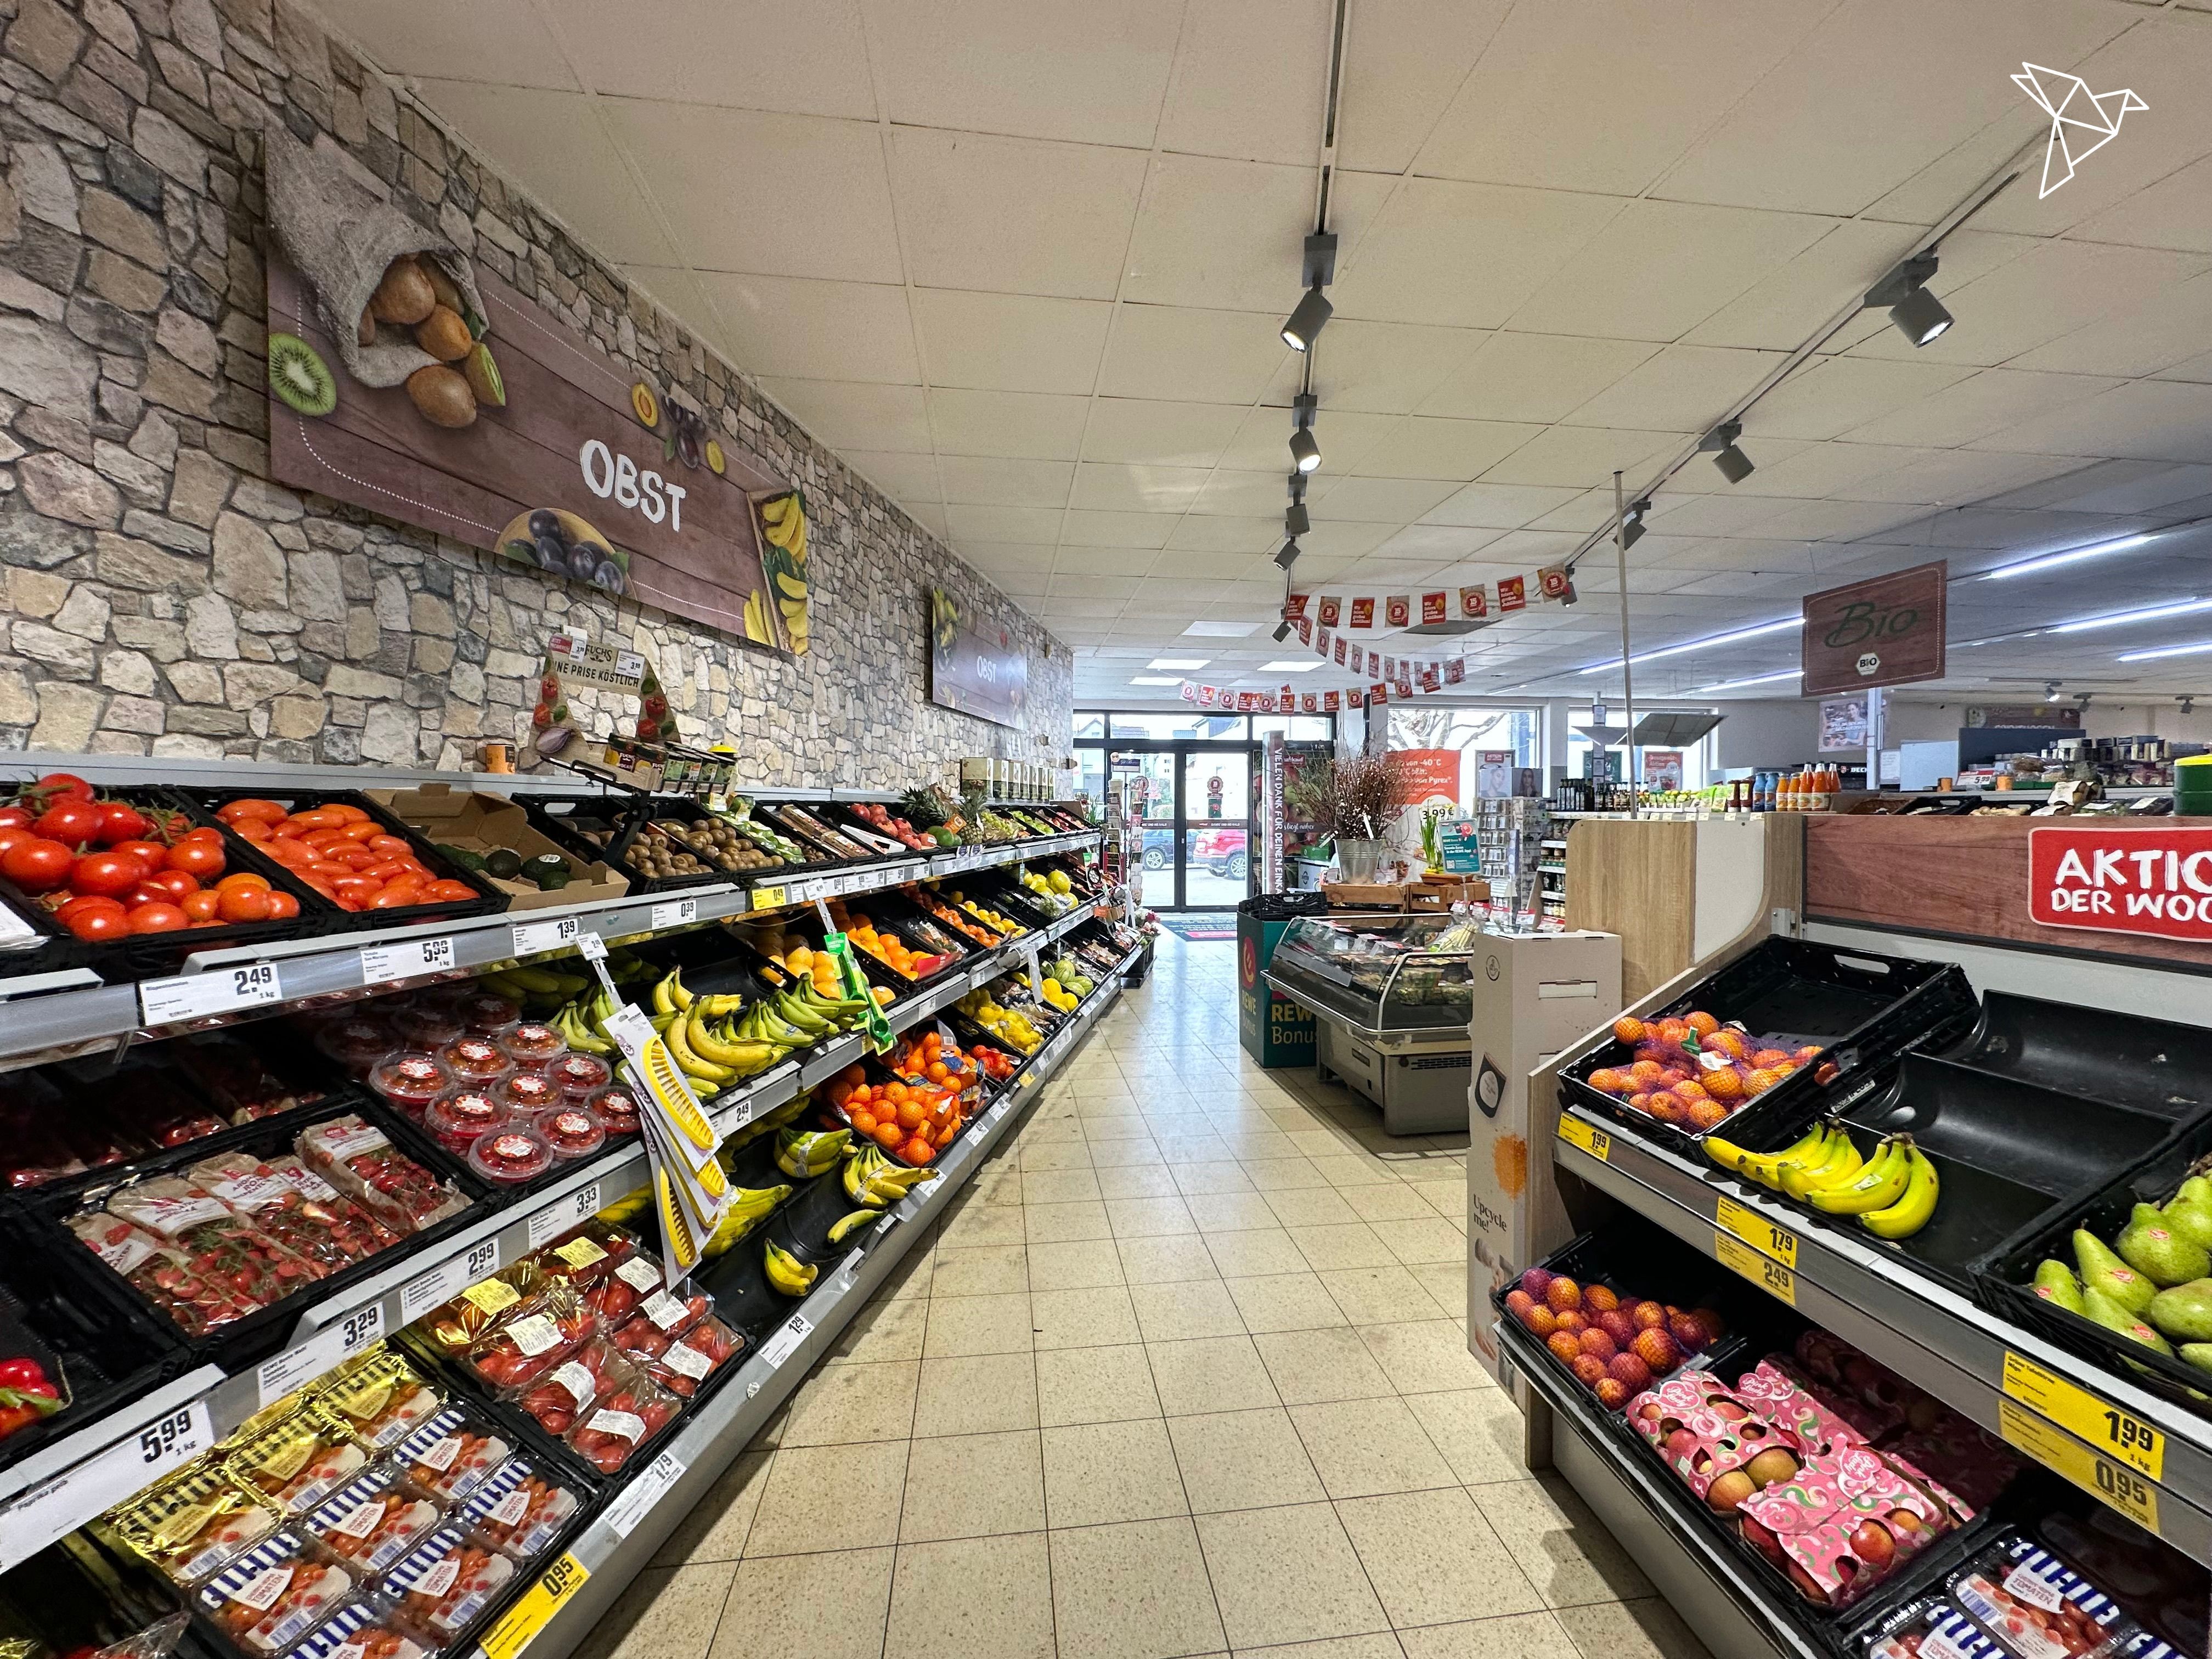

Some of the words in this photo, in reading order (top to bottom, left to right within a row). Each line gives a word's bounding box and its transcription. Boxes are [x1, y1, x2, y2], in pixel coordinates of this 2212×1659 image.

[579, 438, 687, 533] OBST
[1824, 601, 1920, 648] Bio
[571, 664, 596, 679] PRISE
[598, 669, 640, 688] KÖSTLICH
[977, 656, 997, 684] OBST
[1274, 747, 1283, 777] VIELEN
[1274, 781, 1283, 809] DANK
[1274, 811, 1284, 831] FÜR
[1274, 832, 1283, 866] DEINEN
[1274, 868, 1283, 894] EINKA
[2053, 848, 2212, 895] AKTIO
[2051, 888, 2115, 915] DER
[2125, 893, 2212, 924] WOC
[557, 921, 575, 939] 1.39
[234, 967, 272, 996] 2.49
[1271, 1003, 1313, 1023] REW
[736, 1102, 749, 1123] 2.49
[1591, 1131, 1607, 1149] 1.99
[577, 1187, 596, 1214] 3.33
[1473, 1193, 1508, 1232] Upcycle
[1473, 1212, 1489, 1233] me!
[1769, 1227, 1793, 1252] 1.79
[468, 1242, 494, 1276] 2.99
[1763, 1261, 1790, 1288] 2.49
[343, 1306, 377, 1347] 3.29
[788, 1316, 805, 1334] 1.29
[1666, 1386, 1696, 1402] Pink
[1740, 1384, 1766, 1397] Lady
[1741, 1375, 1769, 1390] Pink
[1662, 1393, 1691, 1407] Lady
[140, 1410, 192, 1464] 5.99
[2104, 1409, 2154, 1453] 1.99
[183, 1440, 196, 1452] kg
[432, 1442, 456, 1465] TOMATEN
[2137, 1460, 2151, 1472] kg
[2095, 1459, 2148, 1507] 0.95
[350, 1508, 379, 1532] TOMATEN
[502, 1496, 525, 1519] TOMATEN
[250, 1574, 285, 1603] TOMATEN
[427, 1566, 453, 1591] TOMATEN
[541, 1558, 574, 1597] 0.95
[2013, 1577, 2054, 1605] TOMATEN
